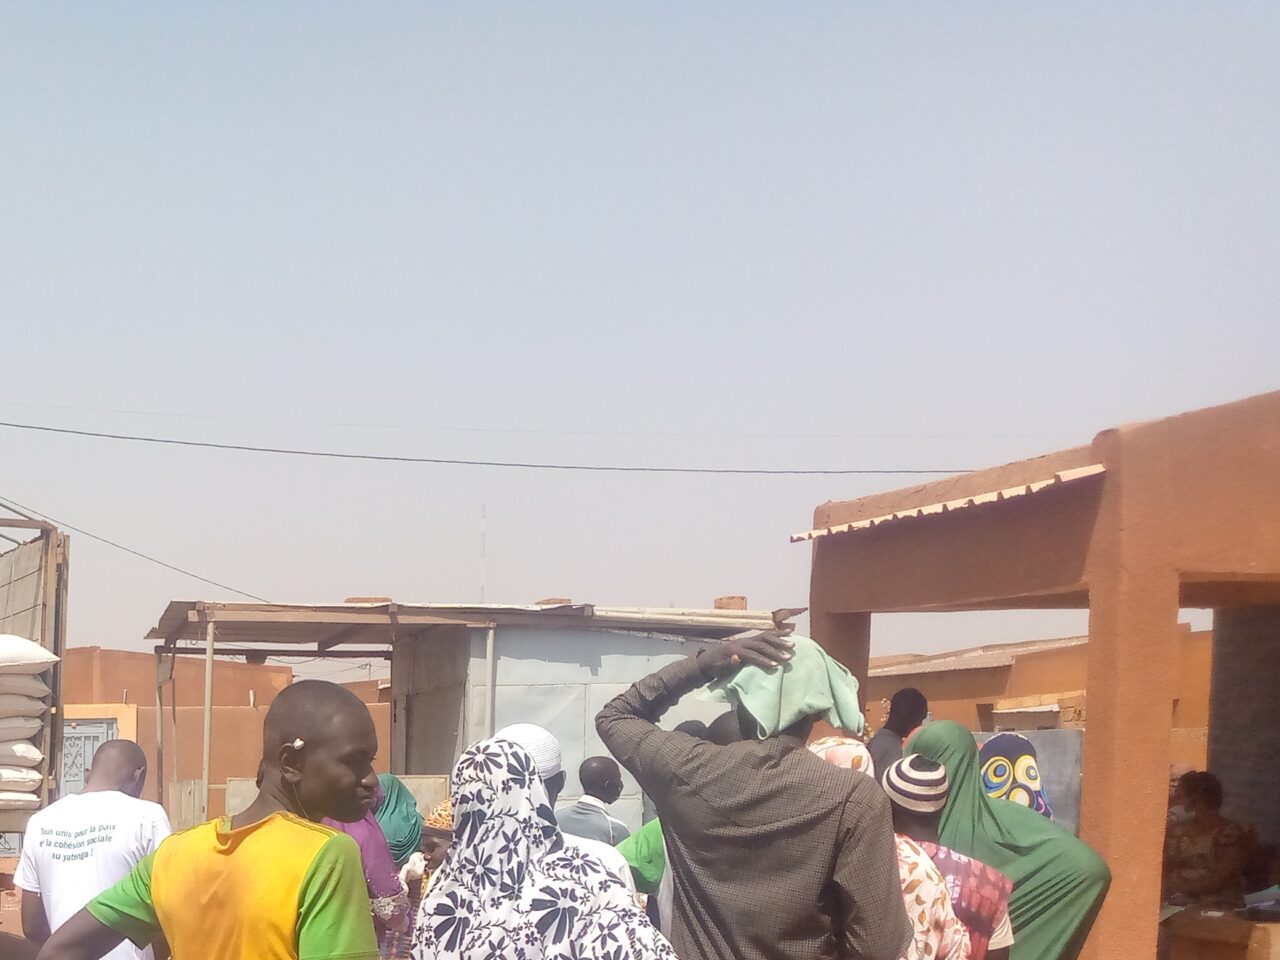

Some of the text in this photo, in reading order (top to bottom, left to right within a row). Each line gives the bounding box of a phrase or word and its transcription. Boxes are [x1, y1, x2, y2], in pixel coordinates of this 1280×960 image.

[41, 824, 116, 839] Tous unis pour la paix
[46, 838, 52, 847] la
[53, 840, 85, 849] cohésion
[86, 834, 113, 846] sociale
[62, 851, 89, 862] yatenga
